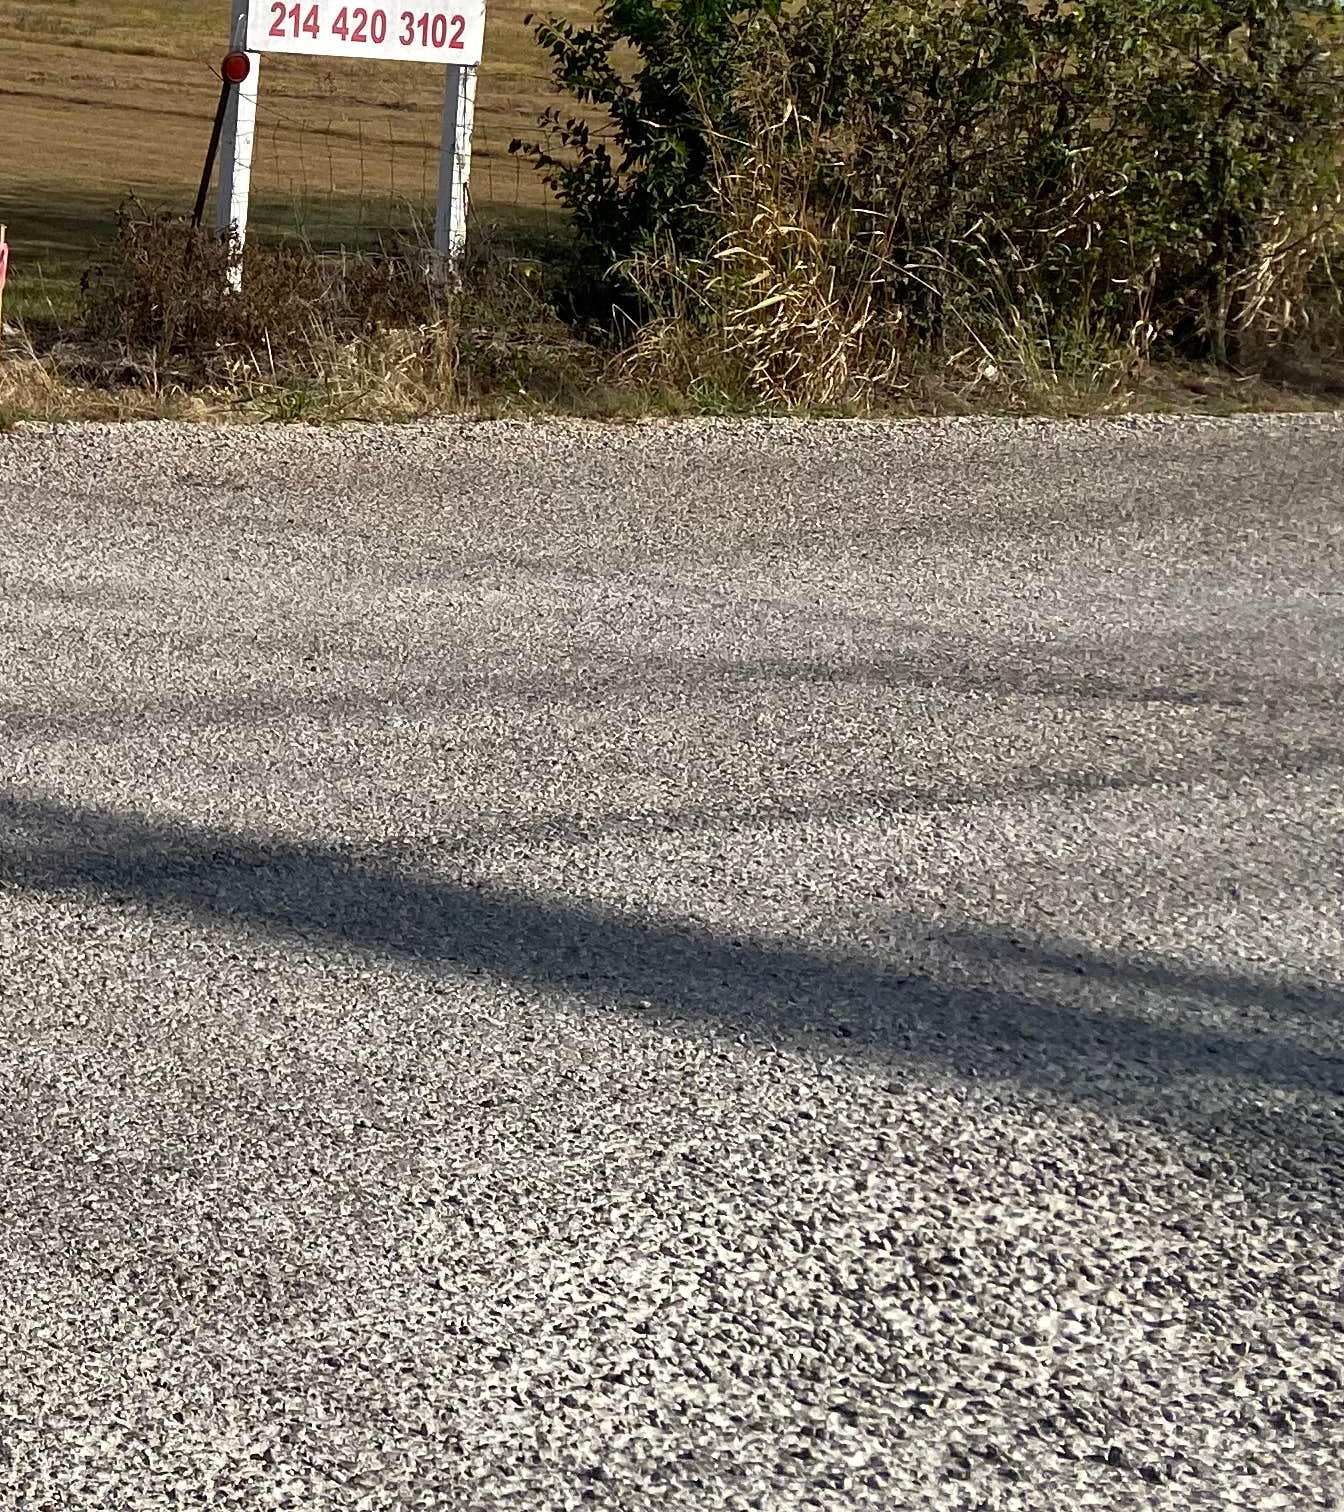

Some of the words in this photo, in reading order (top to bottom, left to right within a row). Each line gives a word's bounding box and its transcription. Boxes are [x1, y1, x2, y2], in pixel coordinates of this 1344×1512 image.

[268, 1, 321, 40] 214
[331, 6, 387, 44] 420
[398, 10, 466, 50] 3102
